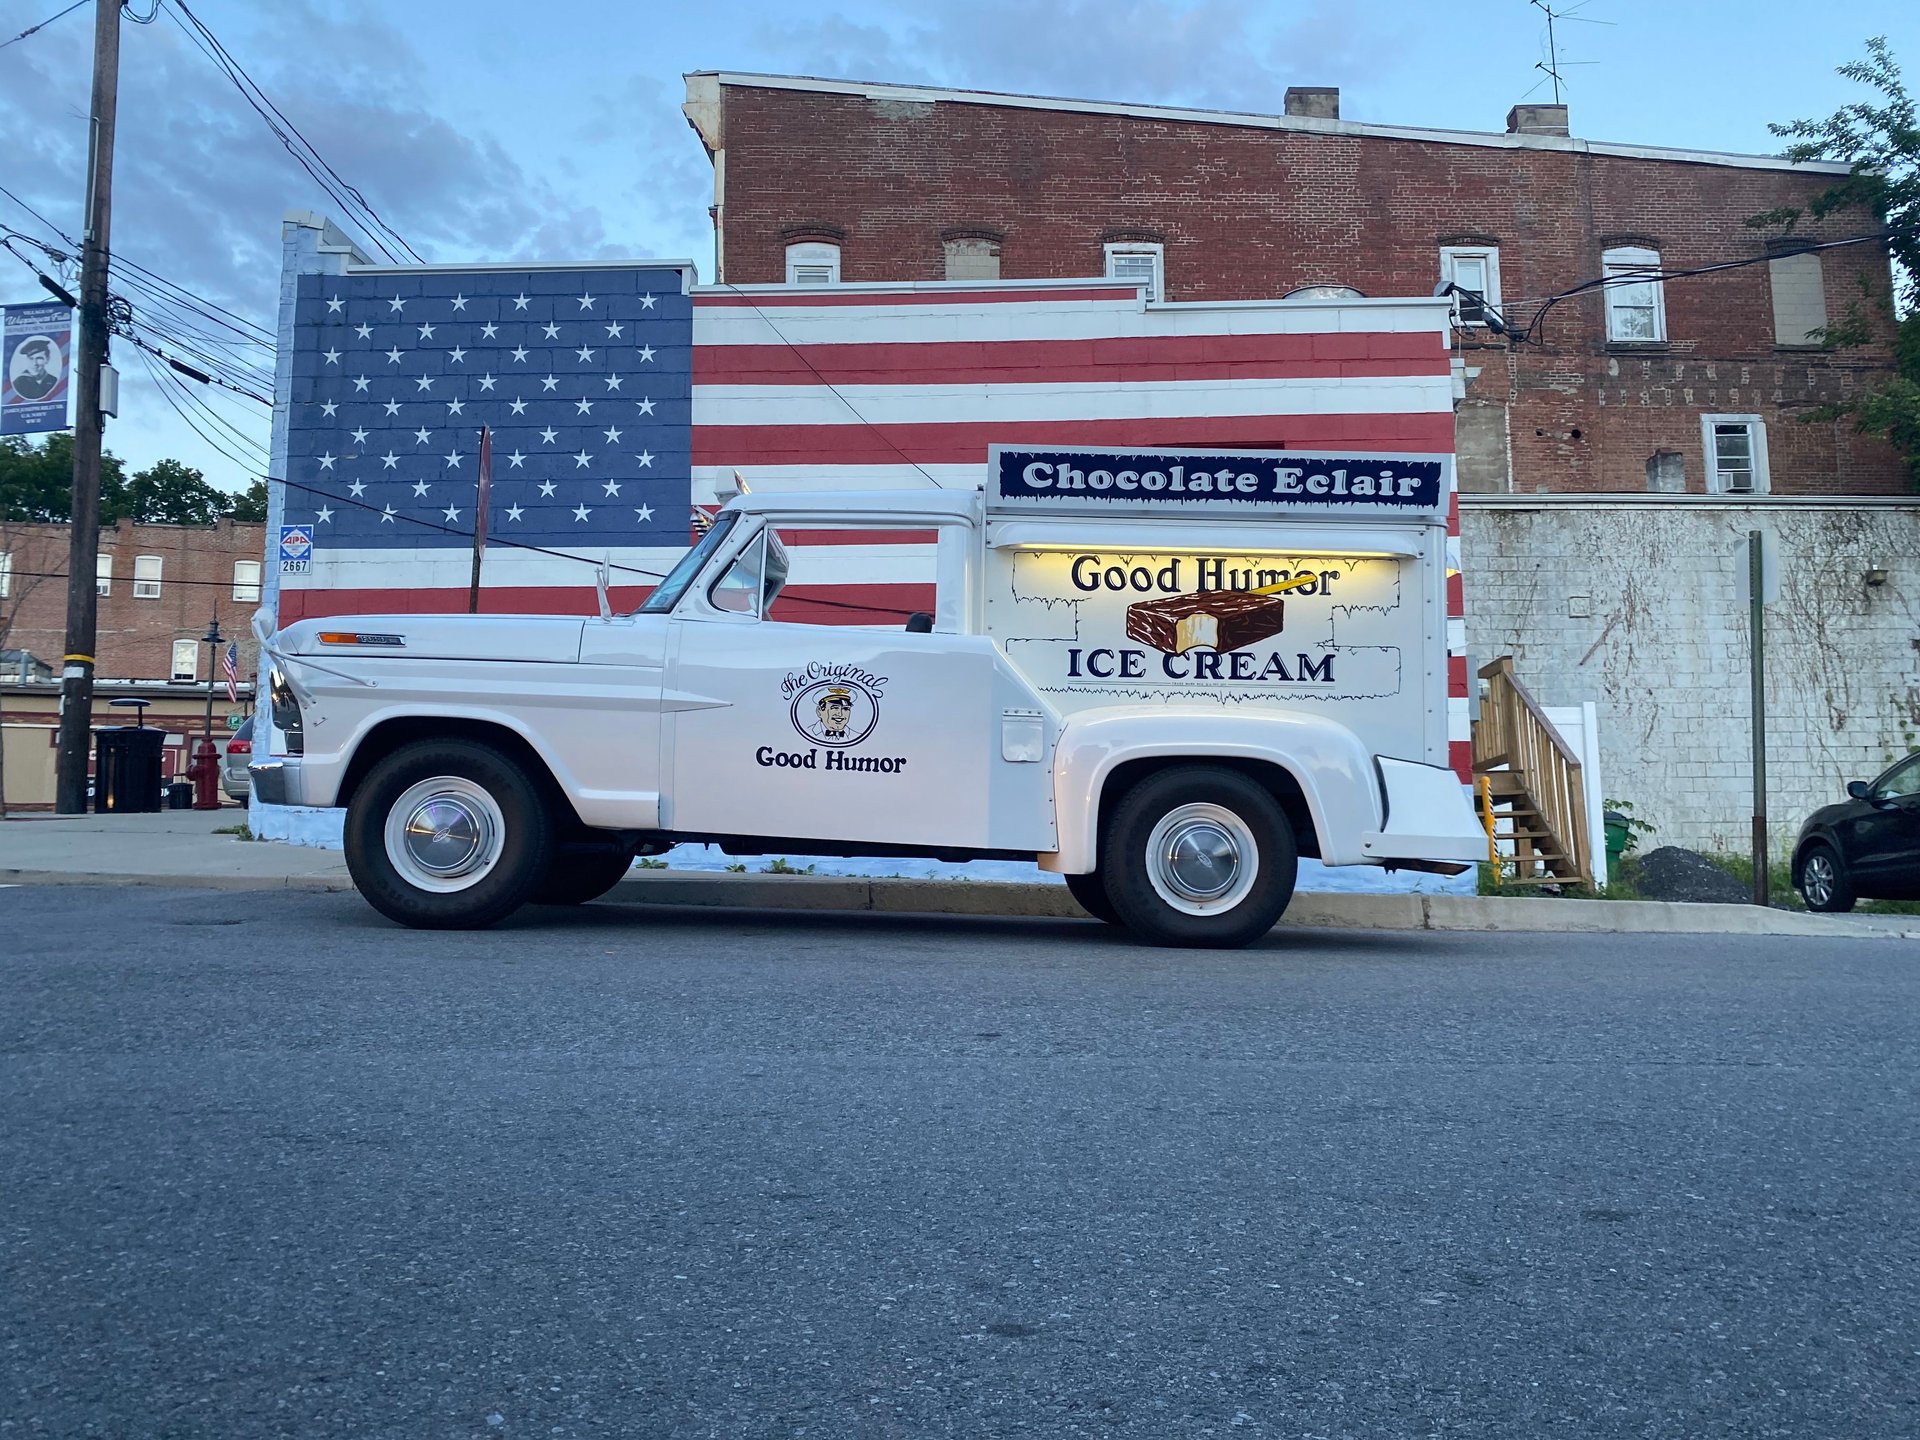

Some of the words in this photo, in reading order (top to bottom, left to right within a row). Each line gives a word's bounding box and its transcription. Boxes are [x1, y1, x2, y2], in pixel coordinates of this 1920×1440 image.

[1022, 461, 1259, 494] Chocolate
[1272, 466, 1422, 498] Eclair
[283, 561, 307, 571] 2667
[1071, 554, 1182, 593] Good
[1197, 558, 1340, 597] Humor
[781, 672, 808, 701] The
[807, 660, 889, 700] Original
[1066, 648, 1147, 678] ICE
[1162, 650, 1336, 683] CREAM
[756, 746, 818, 769] Good
[825, 750, 907, 773] Humor
